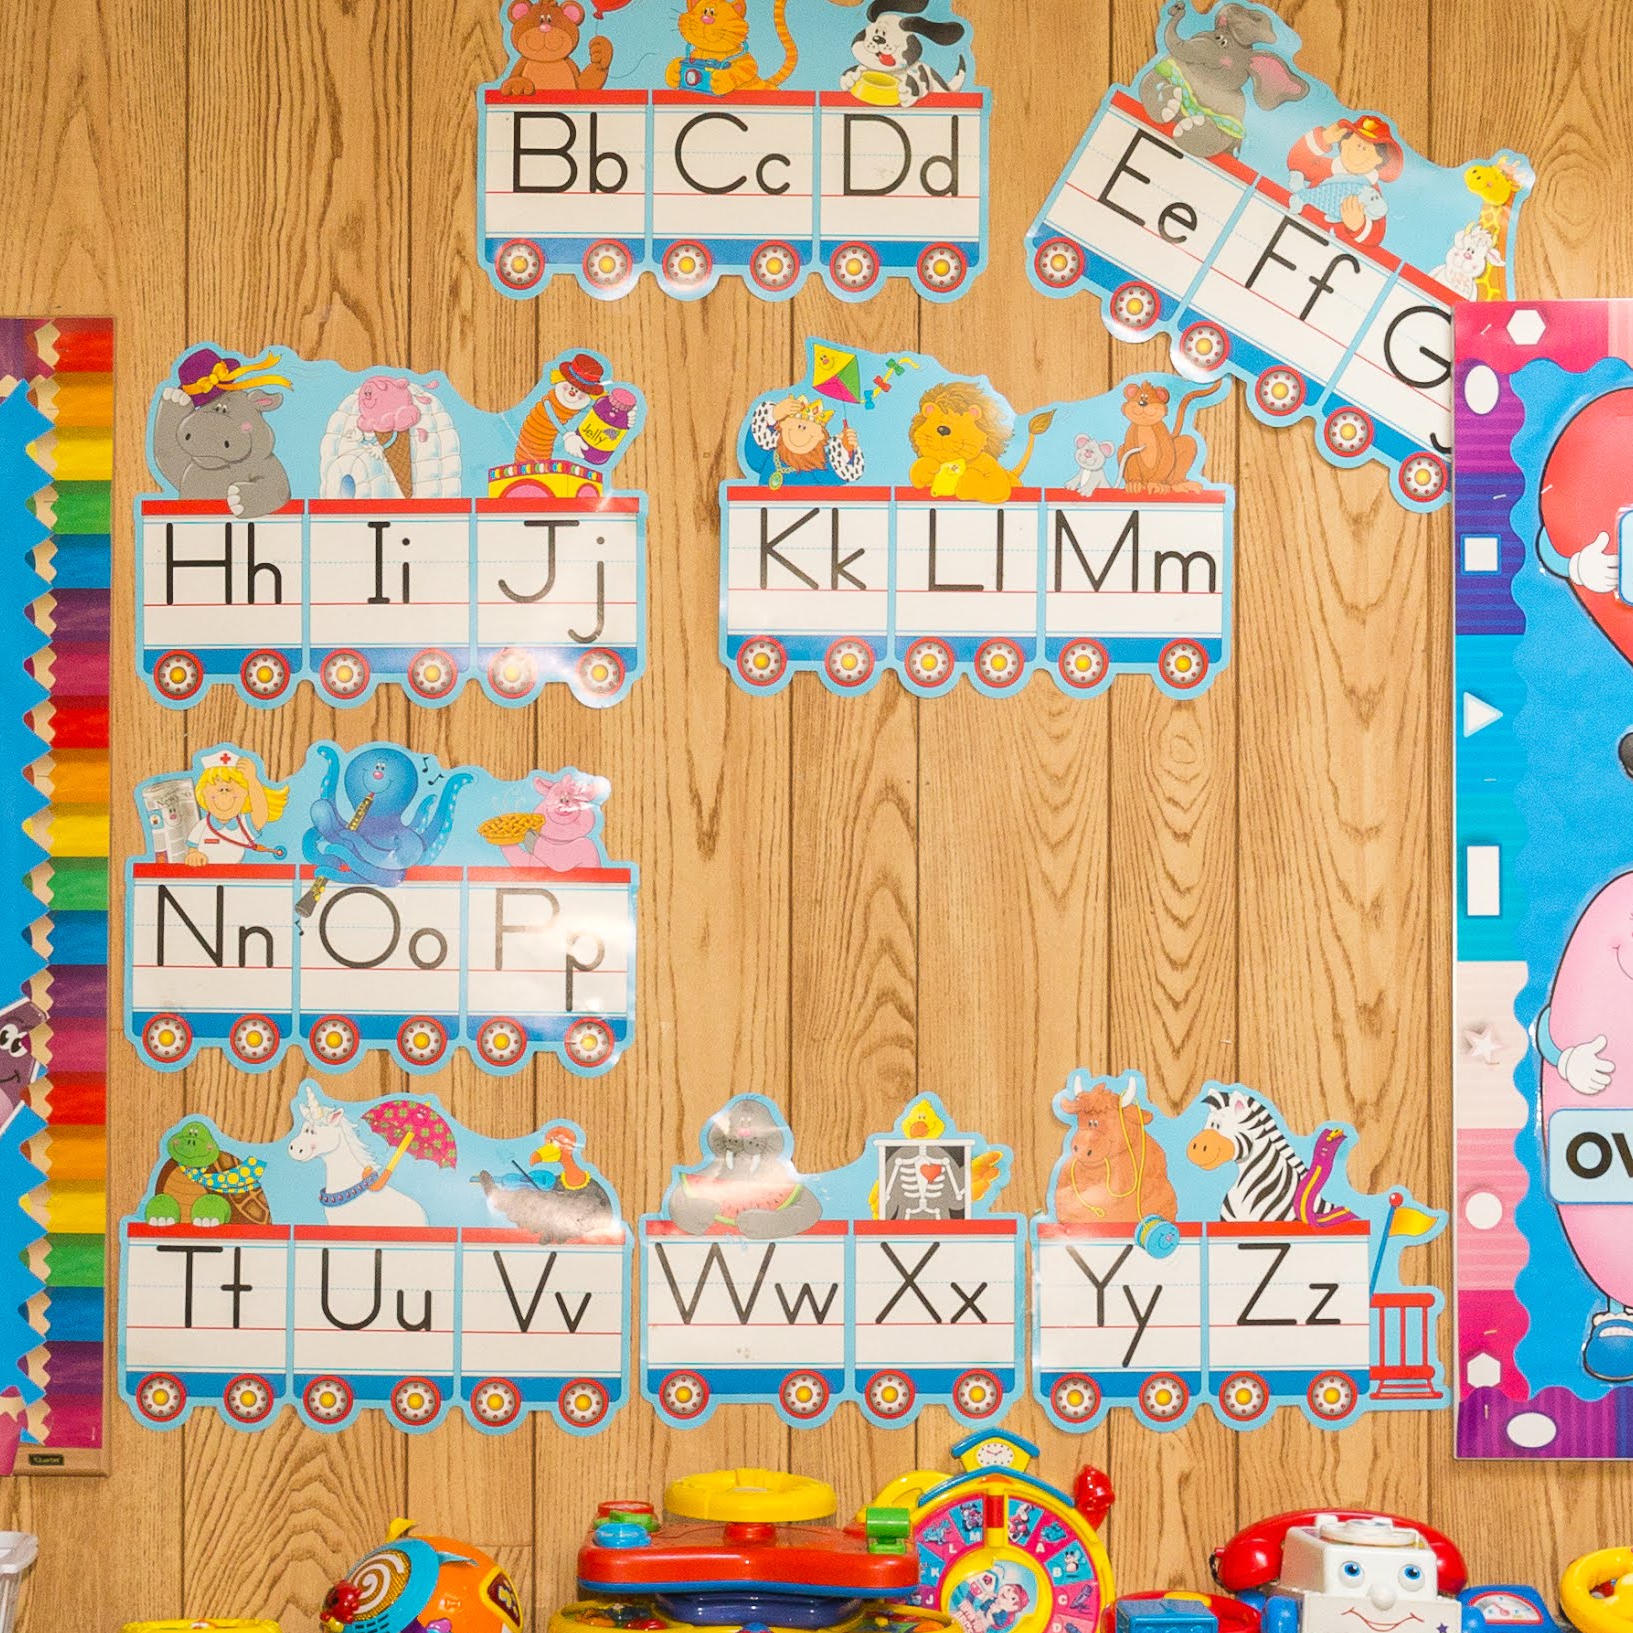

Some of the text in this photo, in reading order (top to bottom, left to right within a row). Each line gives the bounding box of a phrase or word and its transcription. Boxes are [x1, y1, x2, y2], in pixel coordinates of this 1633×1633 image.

[512, 111, 959, 197] Bb Cc Dd
[1096, 128, 1199, 245] Ee
[1244, 215, 1361, 322] Ff
[582, 424, 606, 445] Jelly
[166, 518, 606, 644] Hh Ii Jj
[759, 506, 1217, 594] Kk Ll Mm
[156, 884, 606, 1013] Nn Oo Pp
[156, 1241, 1342, 1368] Tt Uu Vv Ww Xx Yy Zz
